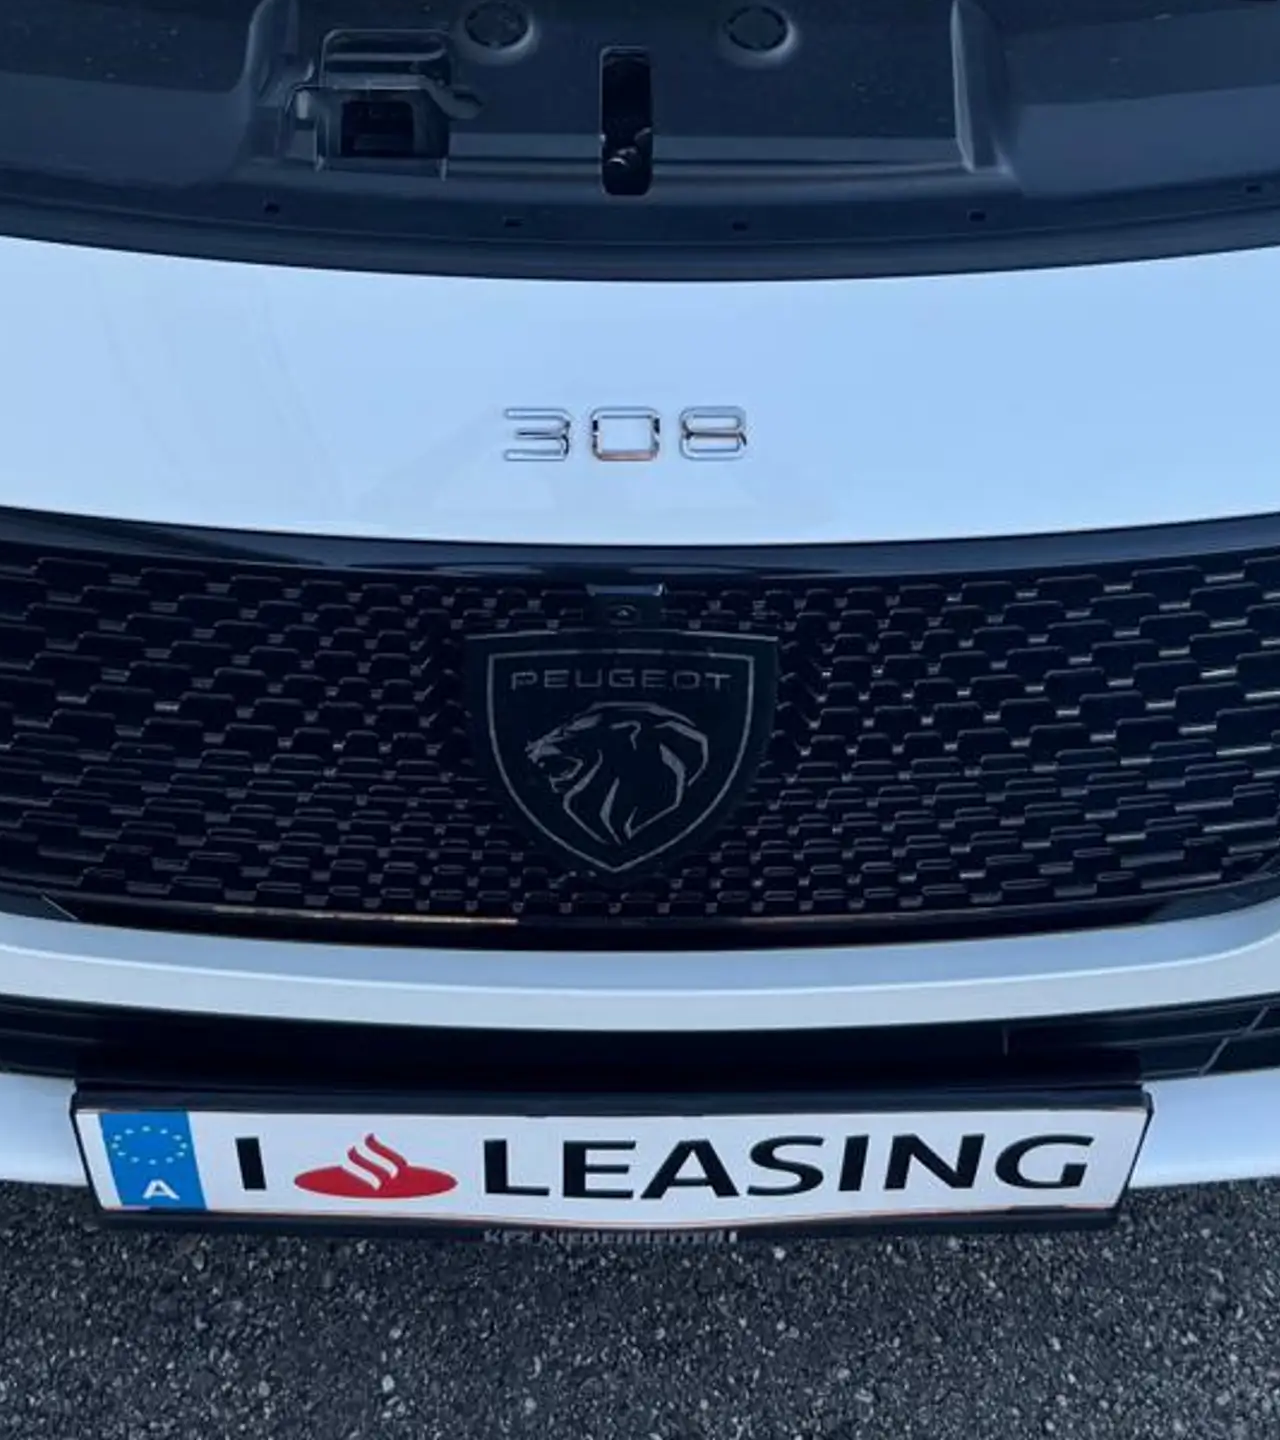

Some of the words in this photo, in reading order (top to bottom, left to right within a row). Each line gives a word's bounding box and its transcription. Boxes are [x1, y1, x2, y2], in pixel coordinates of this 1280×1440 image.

[503, 406, 747, 461] 308
[509, 668, 732, 691] PEUGEOT
[235, 1136, 267, 1191] I
[483, 1133, 1095, 1200] LEASING
[142, 1179, 181, 1200] A
